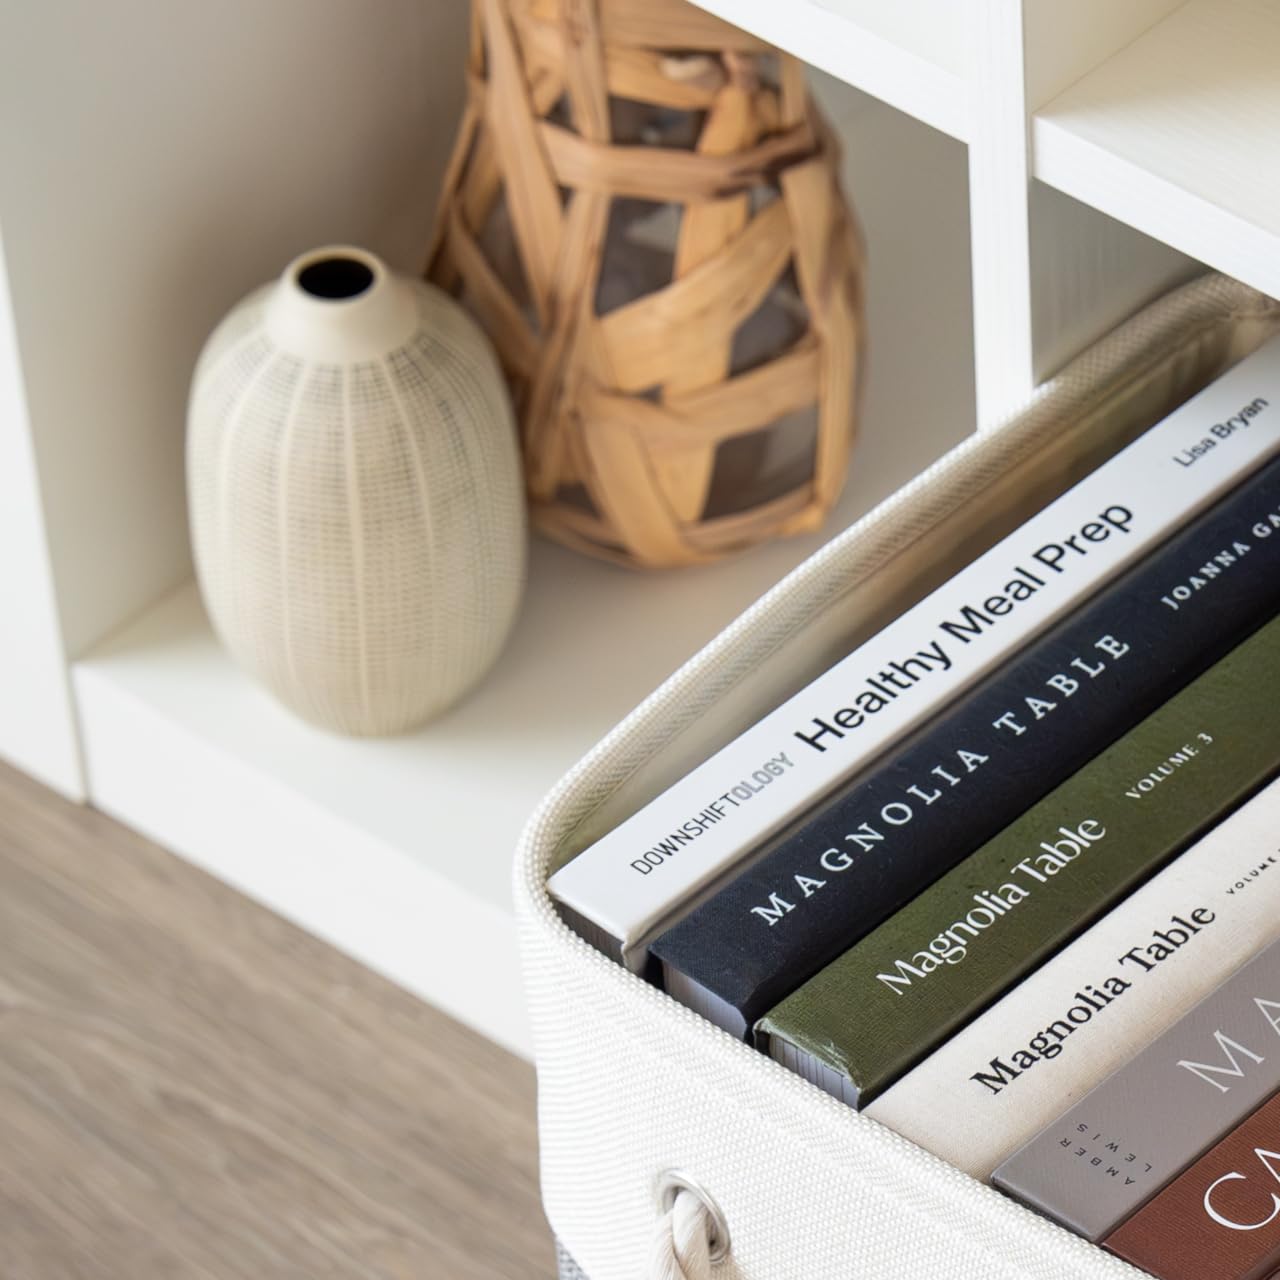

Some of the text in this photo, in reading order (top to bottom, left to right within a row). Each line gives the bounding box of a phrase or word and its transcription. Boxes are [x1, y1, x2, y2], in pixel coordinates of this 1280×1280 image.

[631, 397, 1269, 875] DOWNSHIFTOLOGY Healthy Meal Prep Lisa Bryan
[750, 748, 989, 927] MAGNOLIA
[992, 633, 1130, 736] TABLE
[1160, 541, 1251, 610] JOANNA
[876, 880, 1030, 996] Magnolia
[1010, 817, 1106, 882] Table
[1125, 747, 1200, 799] VOLUME
[1197, 733, 1213, 745] 3
[969, 977, 1131, 1095] Magnolia
[1118, 907, 1216, 973] Table
[1226, 856, 1277, 894] VOLUME
[1060, 1138, 1135, 1185] AMBER
[1077, 1123, 1152, 1172] LEWIS
